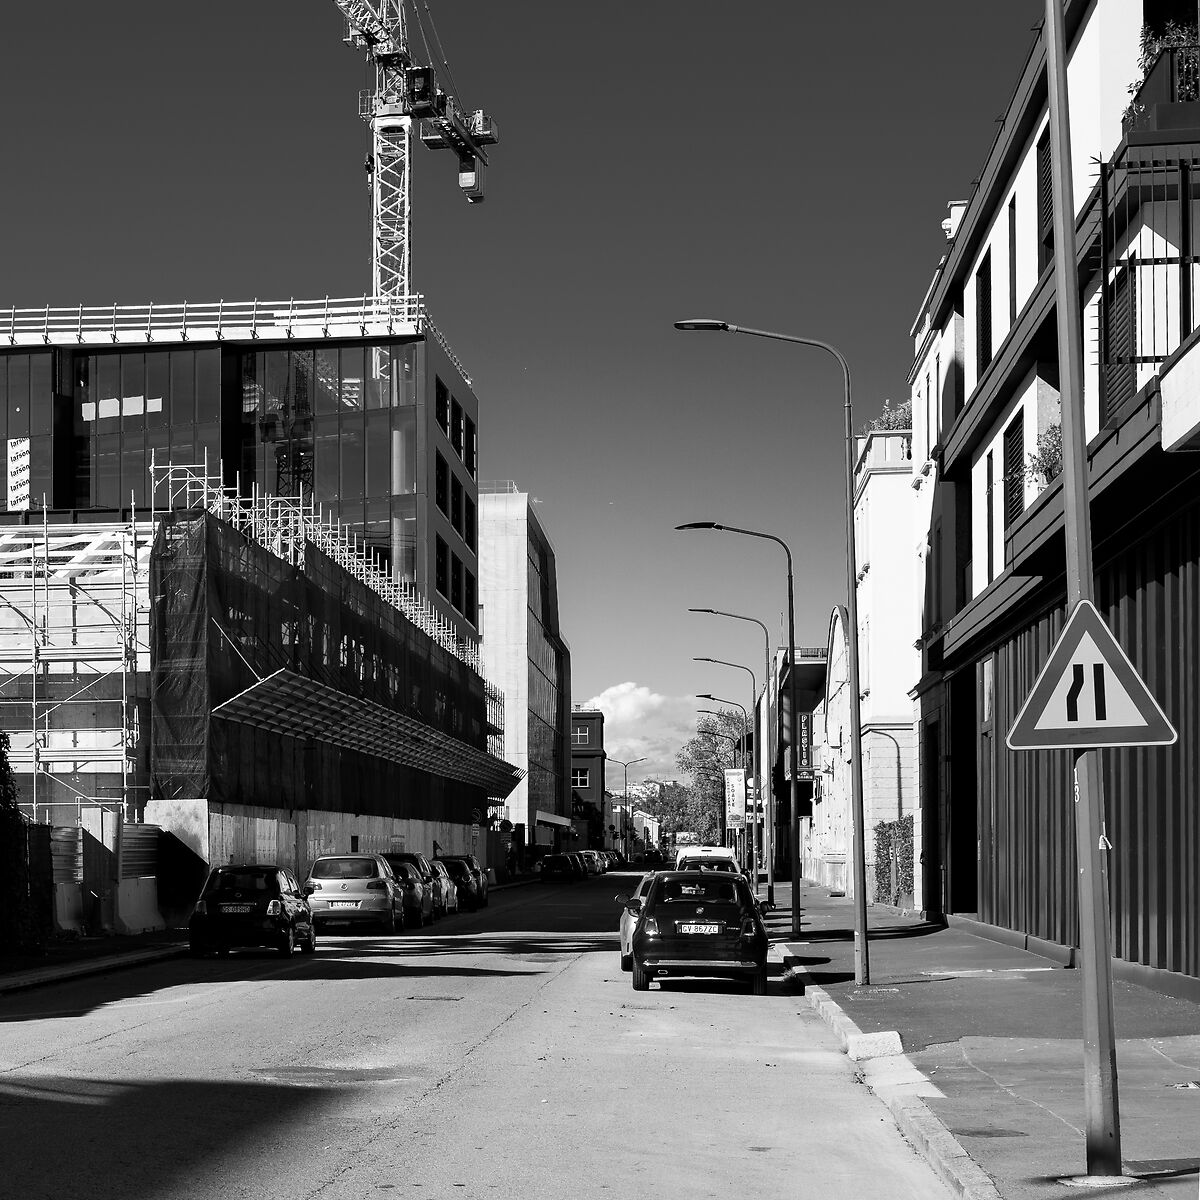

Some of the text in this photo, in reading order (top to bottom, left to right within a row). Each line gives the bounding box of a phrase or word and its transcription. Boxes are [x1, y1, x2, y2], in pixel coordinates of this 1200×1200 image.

[10, 450, 30, 463] larson
[10, 465, 30, 478] larson
[10, 479, 30, 492] larson
[10, 494, 30, 507] larson
